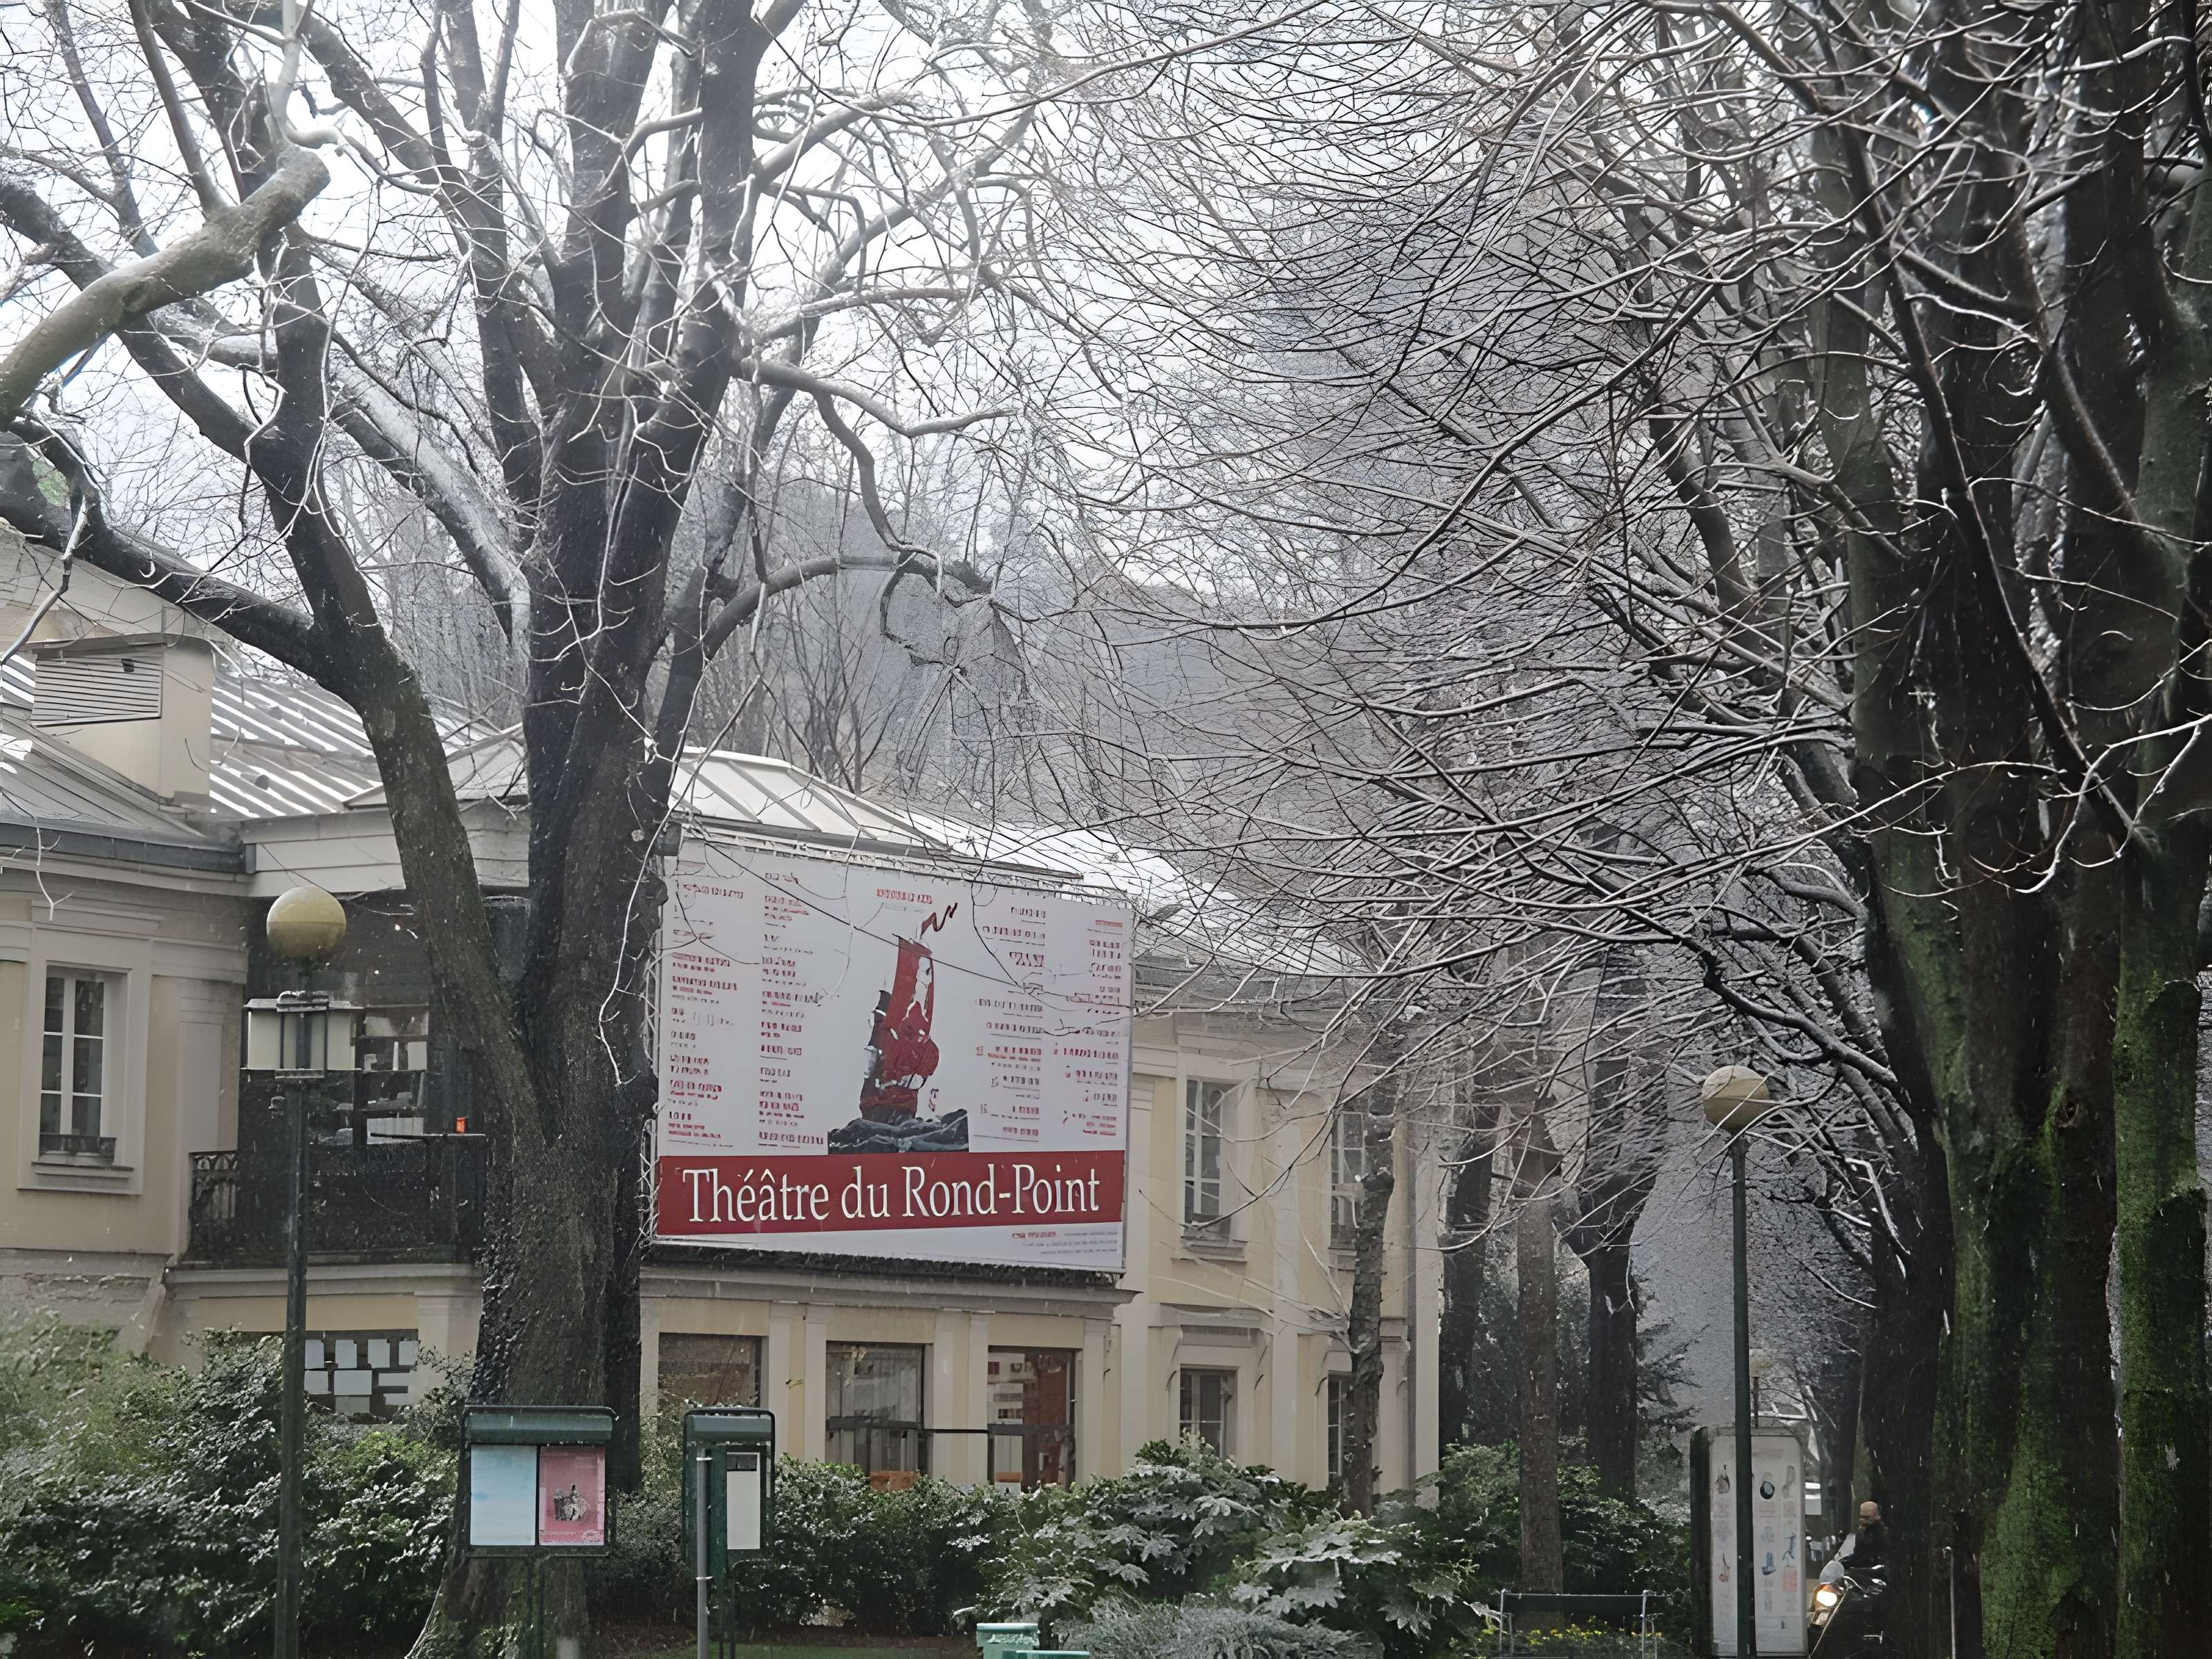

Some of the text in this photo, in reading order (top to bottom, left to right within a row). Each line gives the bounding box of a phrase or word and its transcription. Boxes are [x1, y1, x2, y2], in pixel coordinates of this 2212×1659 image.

[682, 1163, 1100, 1221] Théâtre du Rond-Point
